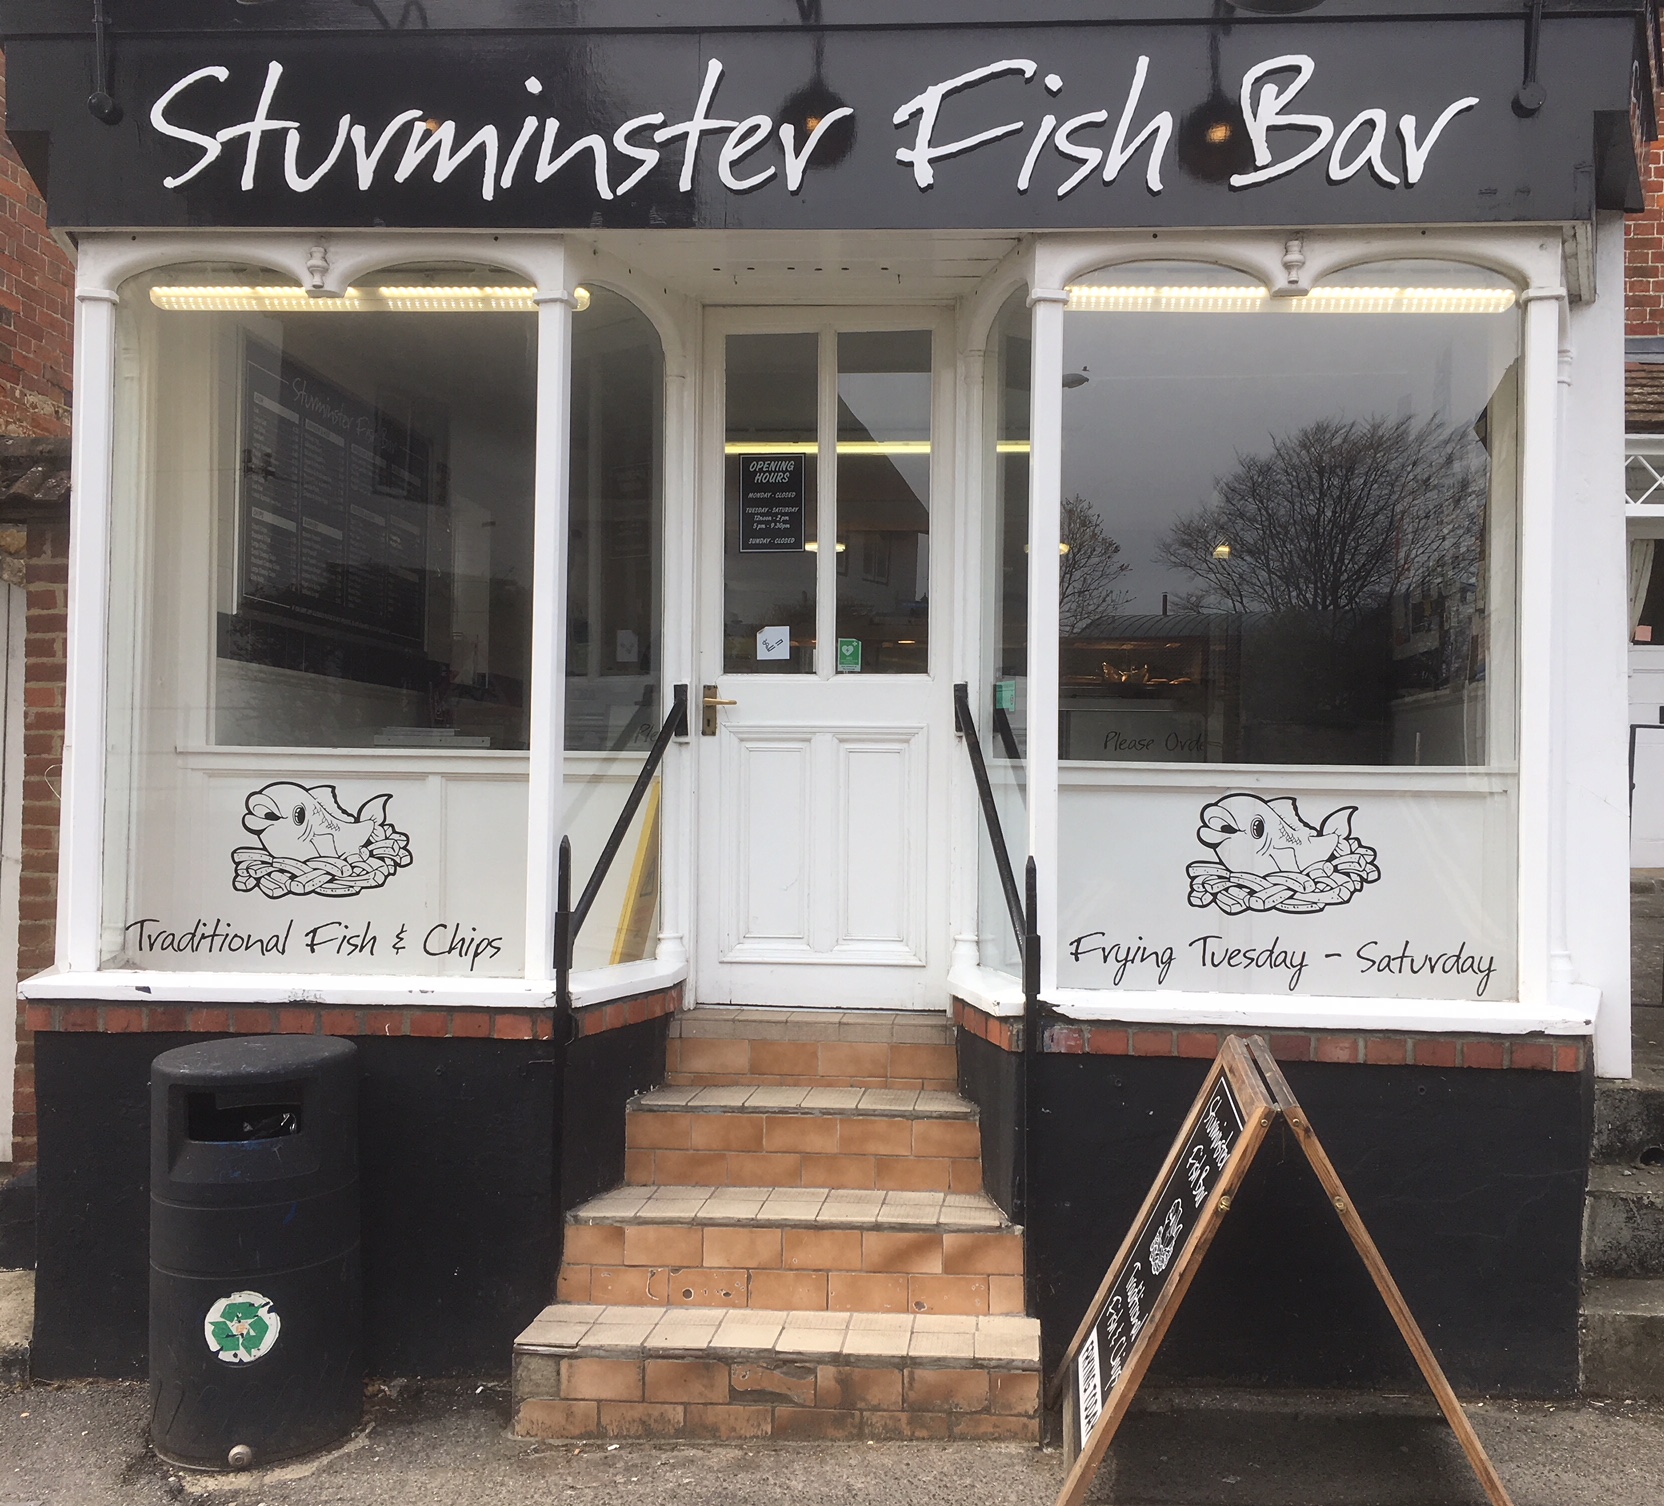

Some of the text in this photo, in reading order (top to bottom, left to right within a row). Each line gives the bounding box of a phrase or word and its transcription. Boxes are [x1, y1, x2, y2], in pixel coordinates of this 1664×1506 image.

[150, 59, 853, 202] Sturminster
[893, 55, 1173, 196] Fish
[1229, 54, 1480, 189] Bar
[749, 461, 795, 471] OPENING
[754, 472, 790, 483] HOURS
[1103, 730, 1155, 752] Please
[125, 919, 503, 972] Traditional Fish & Chips
[1069, 931, 1177, 986] Frying
[1188, 935, 1309, 991] Tuesday
[1355, 940, 1497, 997] Saturday
[1186, 1145, 1210, 1208] Fish Bar
[1106, 1295, 1124, 1339] Fish
[1126, 1262, 1149, 1342] Traditional
[1081, 1340, 1100, 1439] FRYING TODAY
